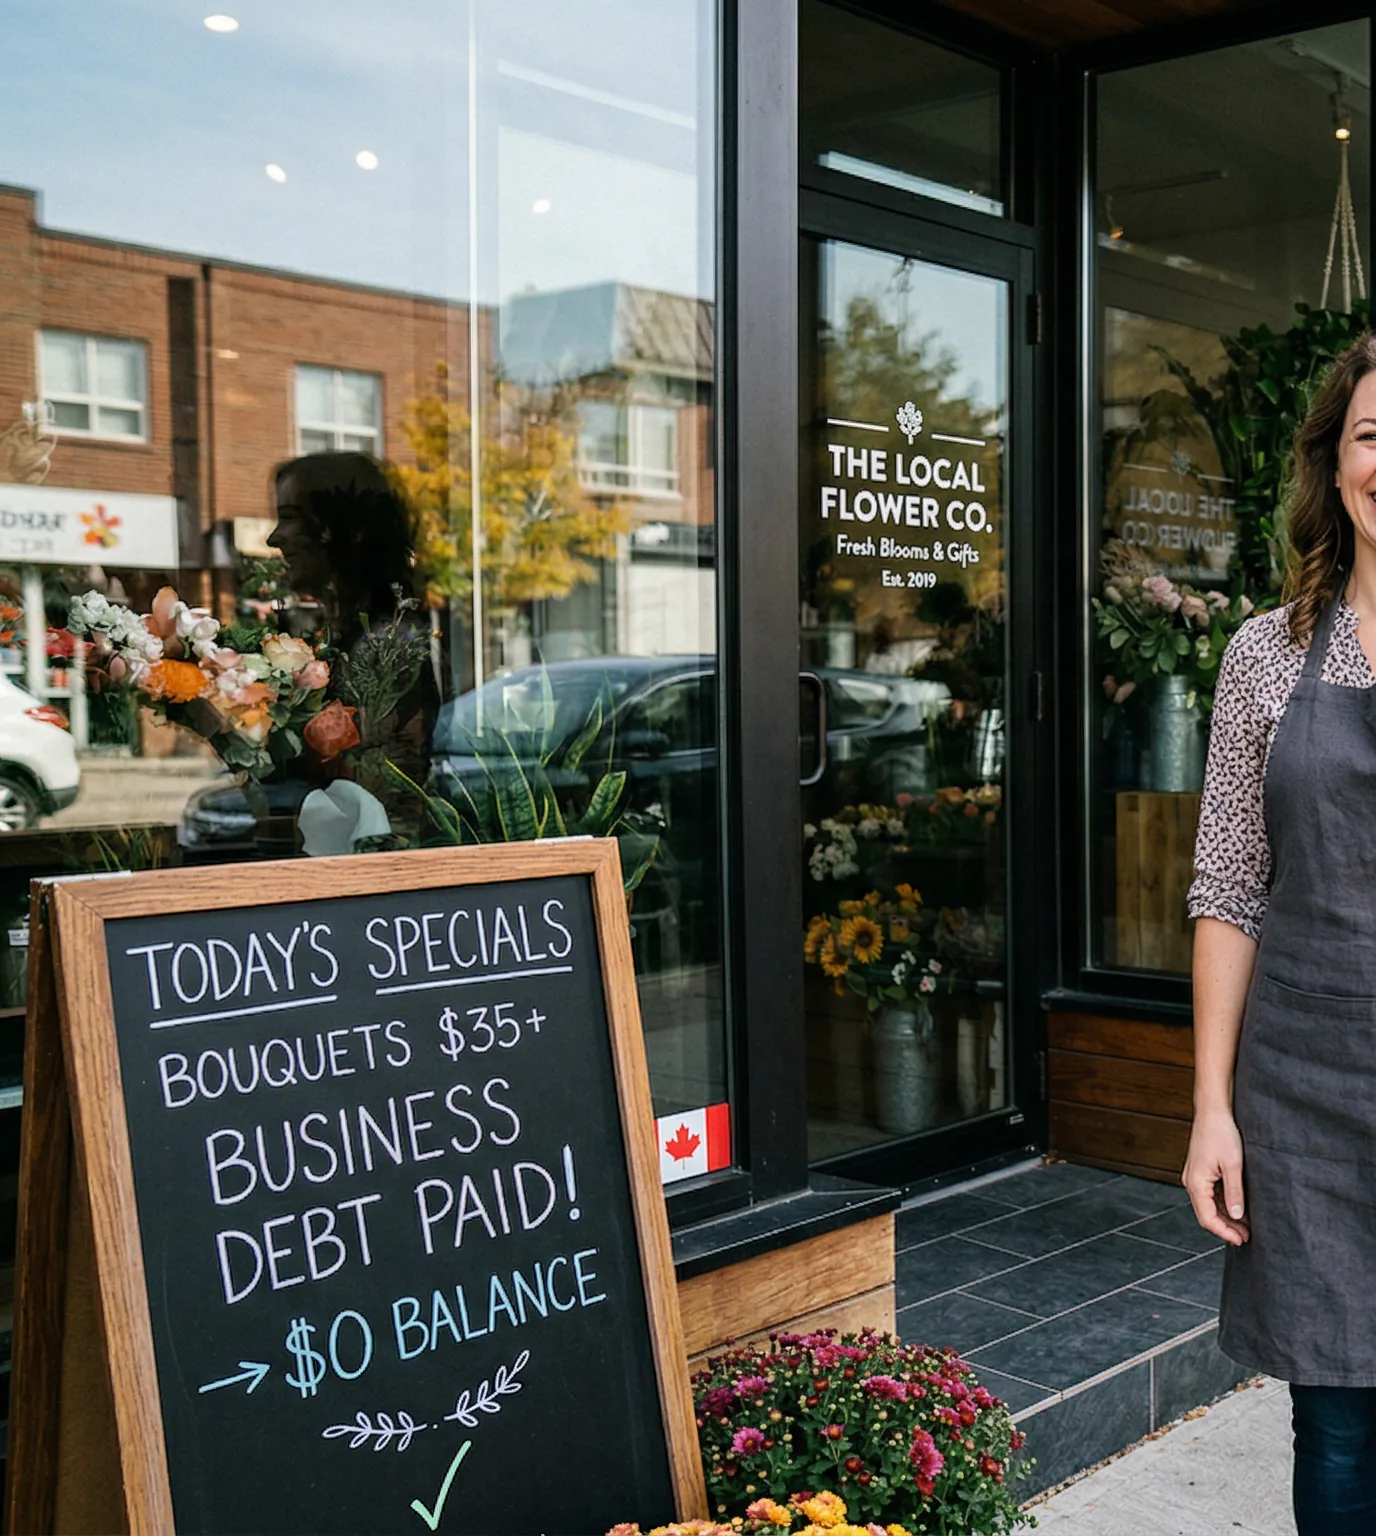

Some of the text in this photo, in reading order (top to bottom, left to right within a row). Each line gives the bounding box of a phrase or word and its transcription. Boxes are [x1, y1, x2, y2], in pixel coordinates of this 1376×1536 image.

[821, 486, 993, 534] FLOWER CO.
[828, 444, 986, 493] THE LOCAL
[836, 534, 980, 569] Fresh Blooms & Gifts
[881, 570, 937, 589] Est. 2019
[126, 899, 574, 1010] TODAY'S SPECIALS
[158, 1003, 547, 1109] BOUQUETS $35+
[204, 1078, 522, 1207] BUSINESS
[215, 1144, 582, 1305] DEBT PAID!
[285, 1248, 607, 1399] $0 BALANCE
